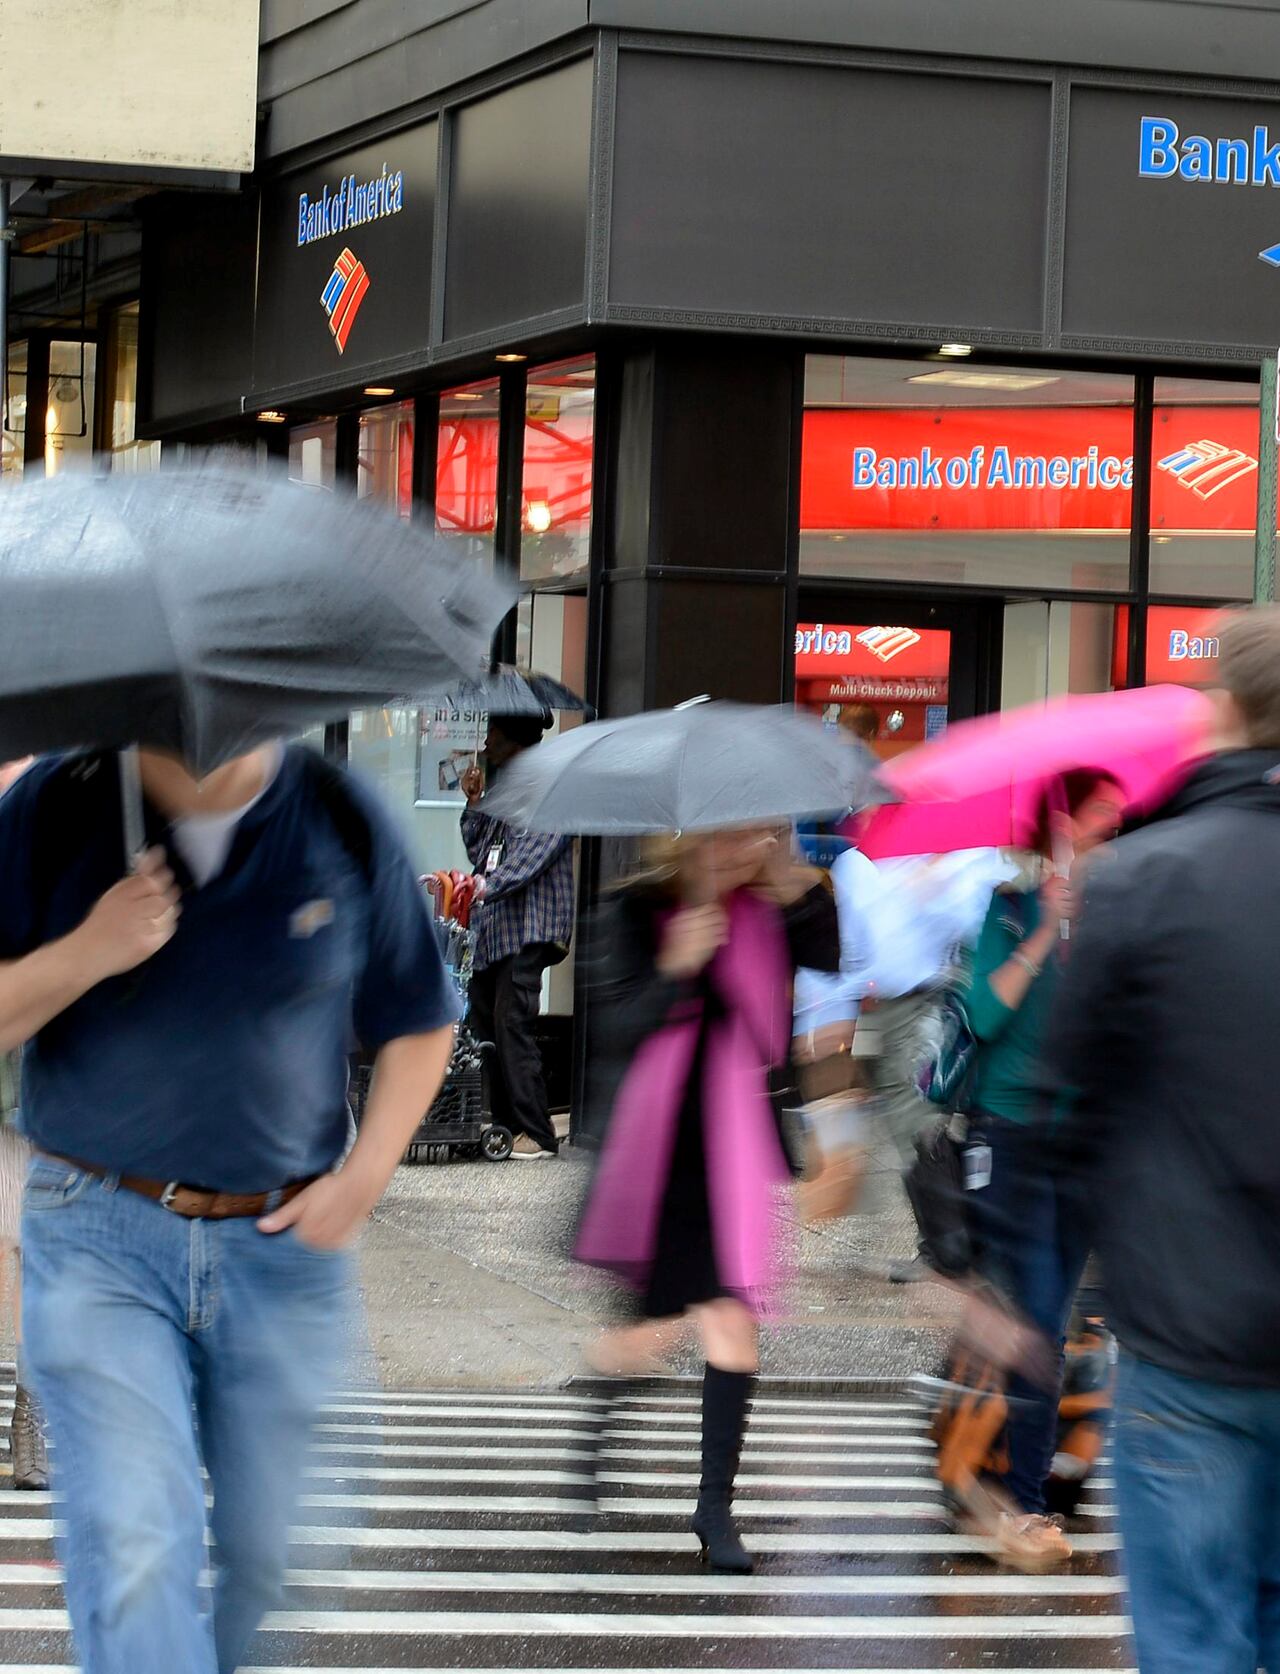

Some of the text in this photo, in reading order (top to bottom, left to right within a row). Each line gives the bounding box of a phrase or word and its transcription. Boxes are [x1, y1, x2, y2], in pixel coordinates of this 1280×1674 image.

[297, 161, 403, 247] Bank of America
[852, 446, 943, 490] Bank
[945, 445, 984, 490] of
[829, 683, 938, 700] Multi-Check Deposit
